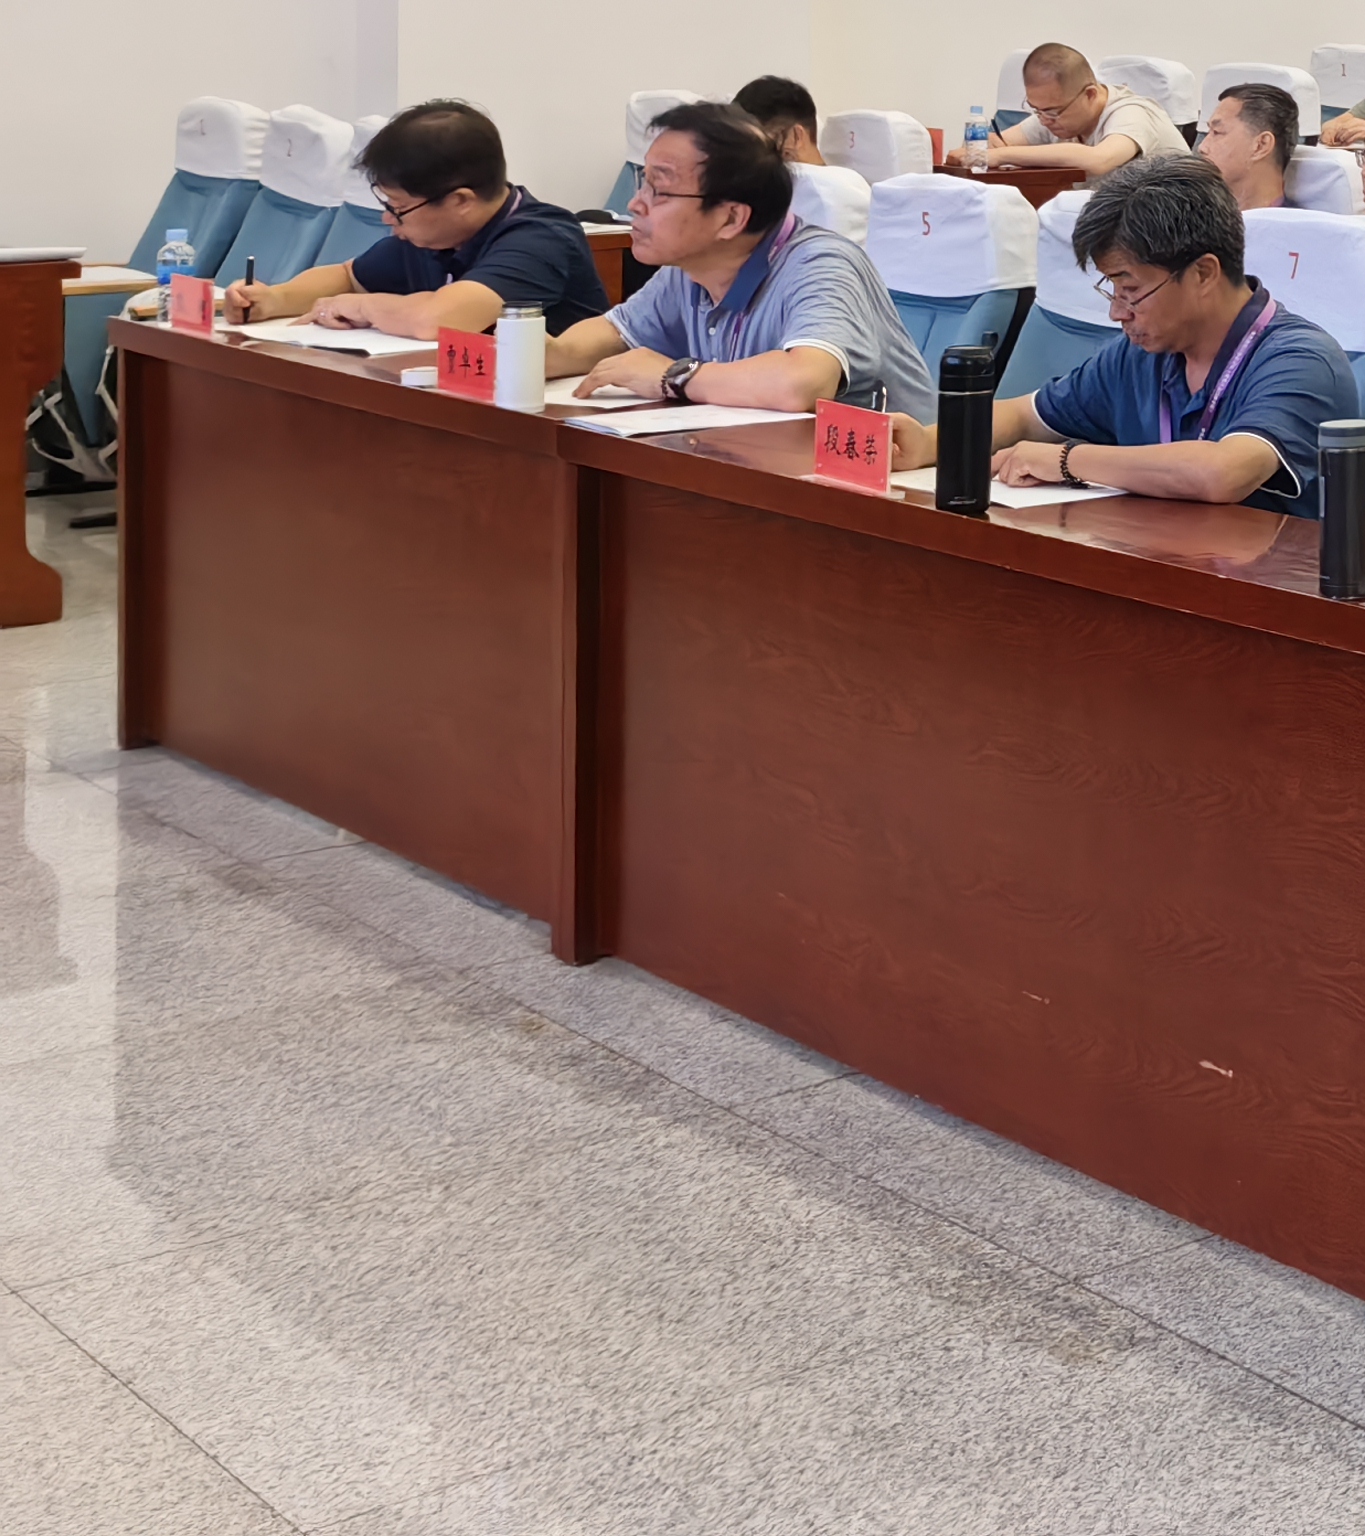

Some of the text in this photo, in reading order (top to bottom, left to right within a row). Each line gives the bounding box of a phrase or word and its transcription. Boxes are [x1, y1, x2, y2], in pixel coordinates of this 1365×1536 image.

[1341, 63, 1347, 77] 1
[921, 211, 931, 237] 5
[1288, 251, 1300, 279] 7
